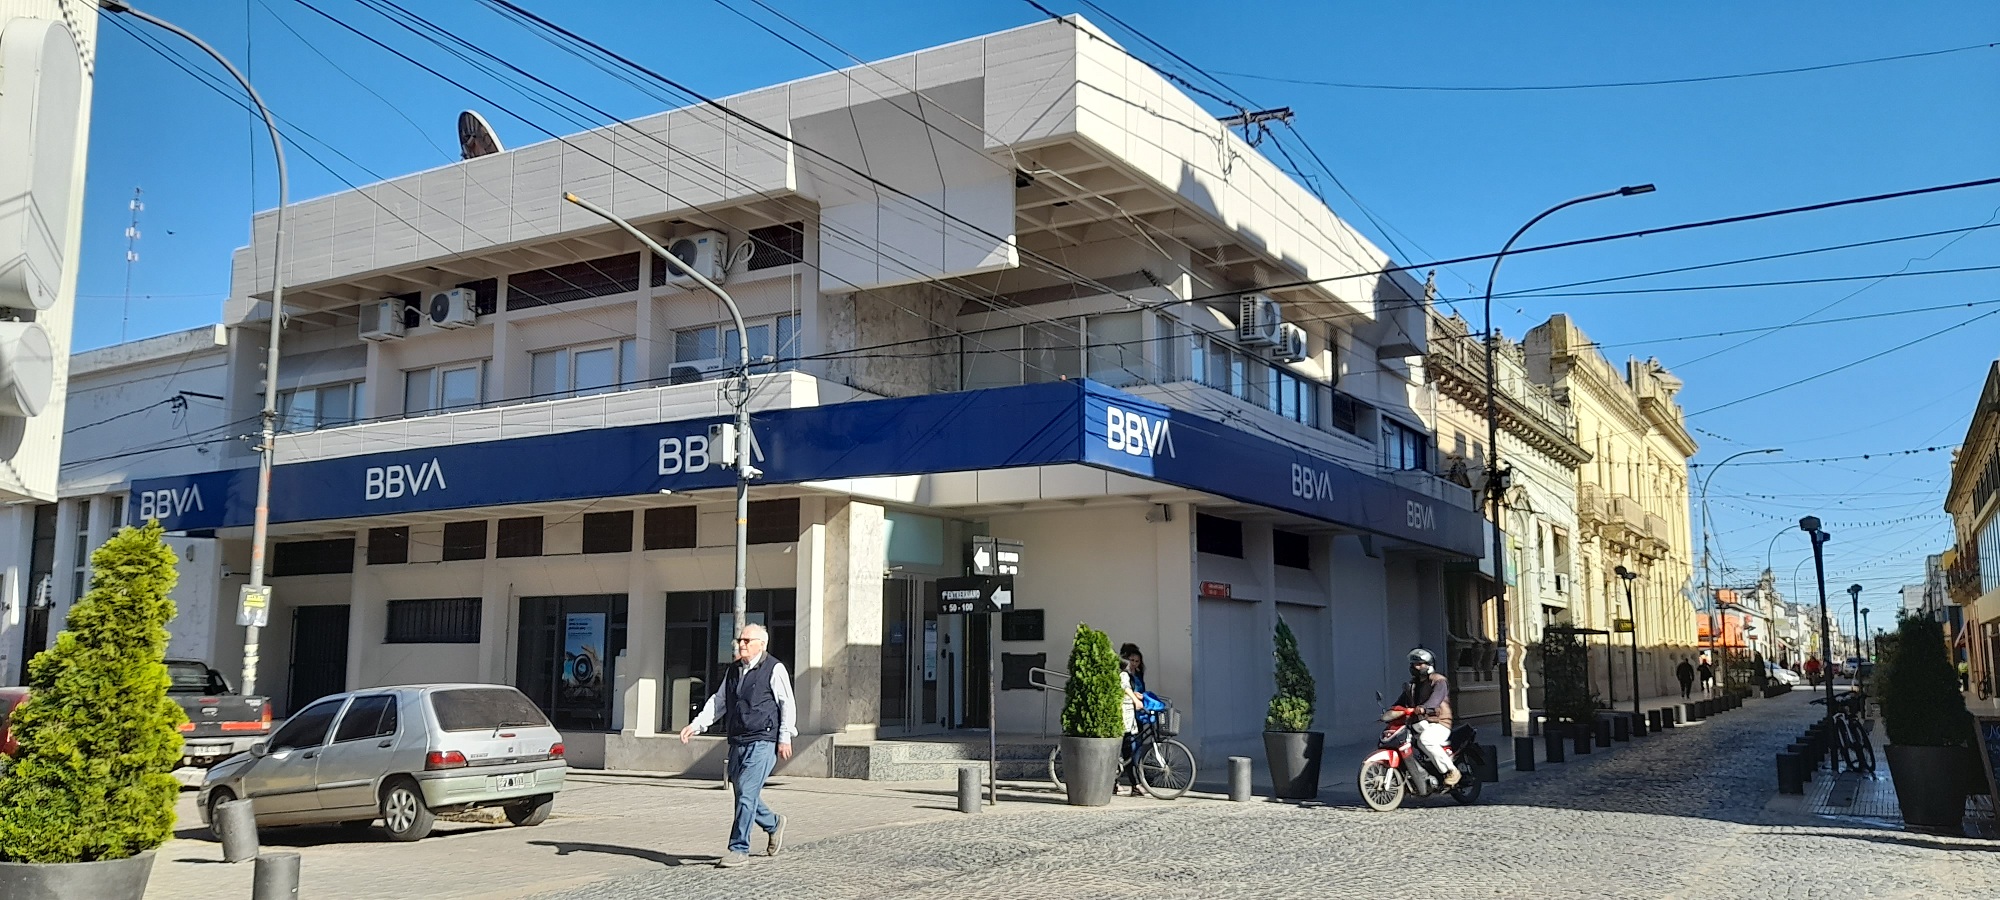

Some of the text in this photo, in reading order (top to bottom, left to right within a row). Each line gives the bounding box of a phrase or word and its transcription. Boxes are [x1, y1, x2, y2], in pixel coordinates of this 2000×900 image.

[658, 427, 765, 475] BB
[1107, 405, 1176, 458] BBVA
[365, 457, 447, 500] BBVA
[1291, 462, 1334, 502] BBVA
[140, 483, 204, 520] BBVA
[1406, 500, 1436, 531] BBVA
